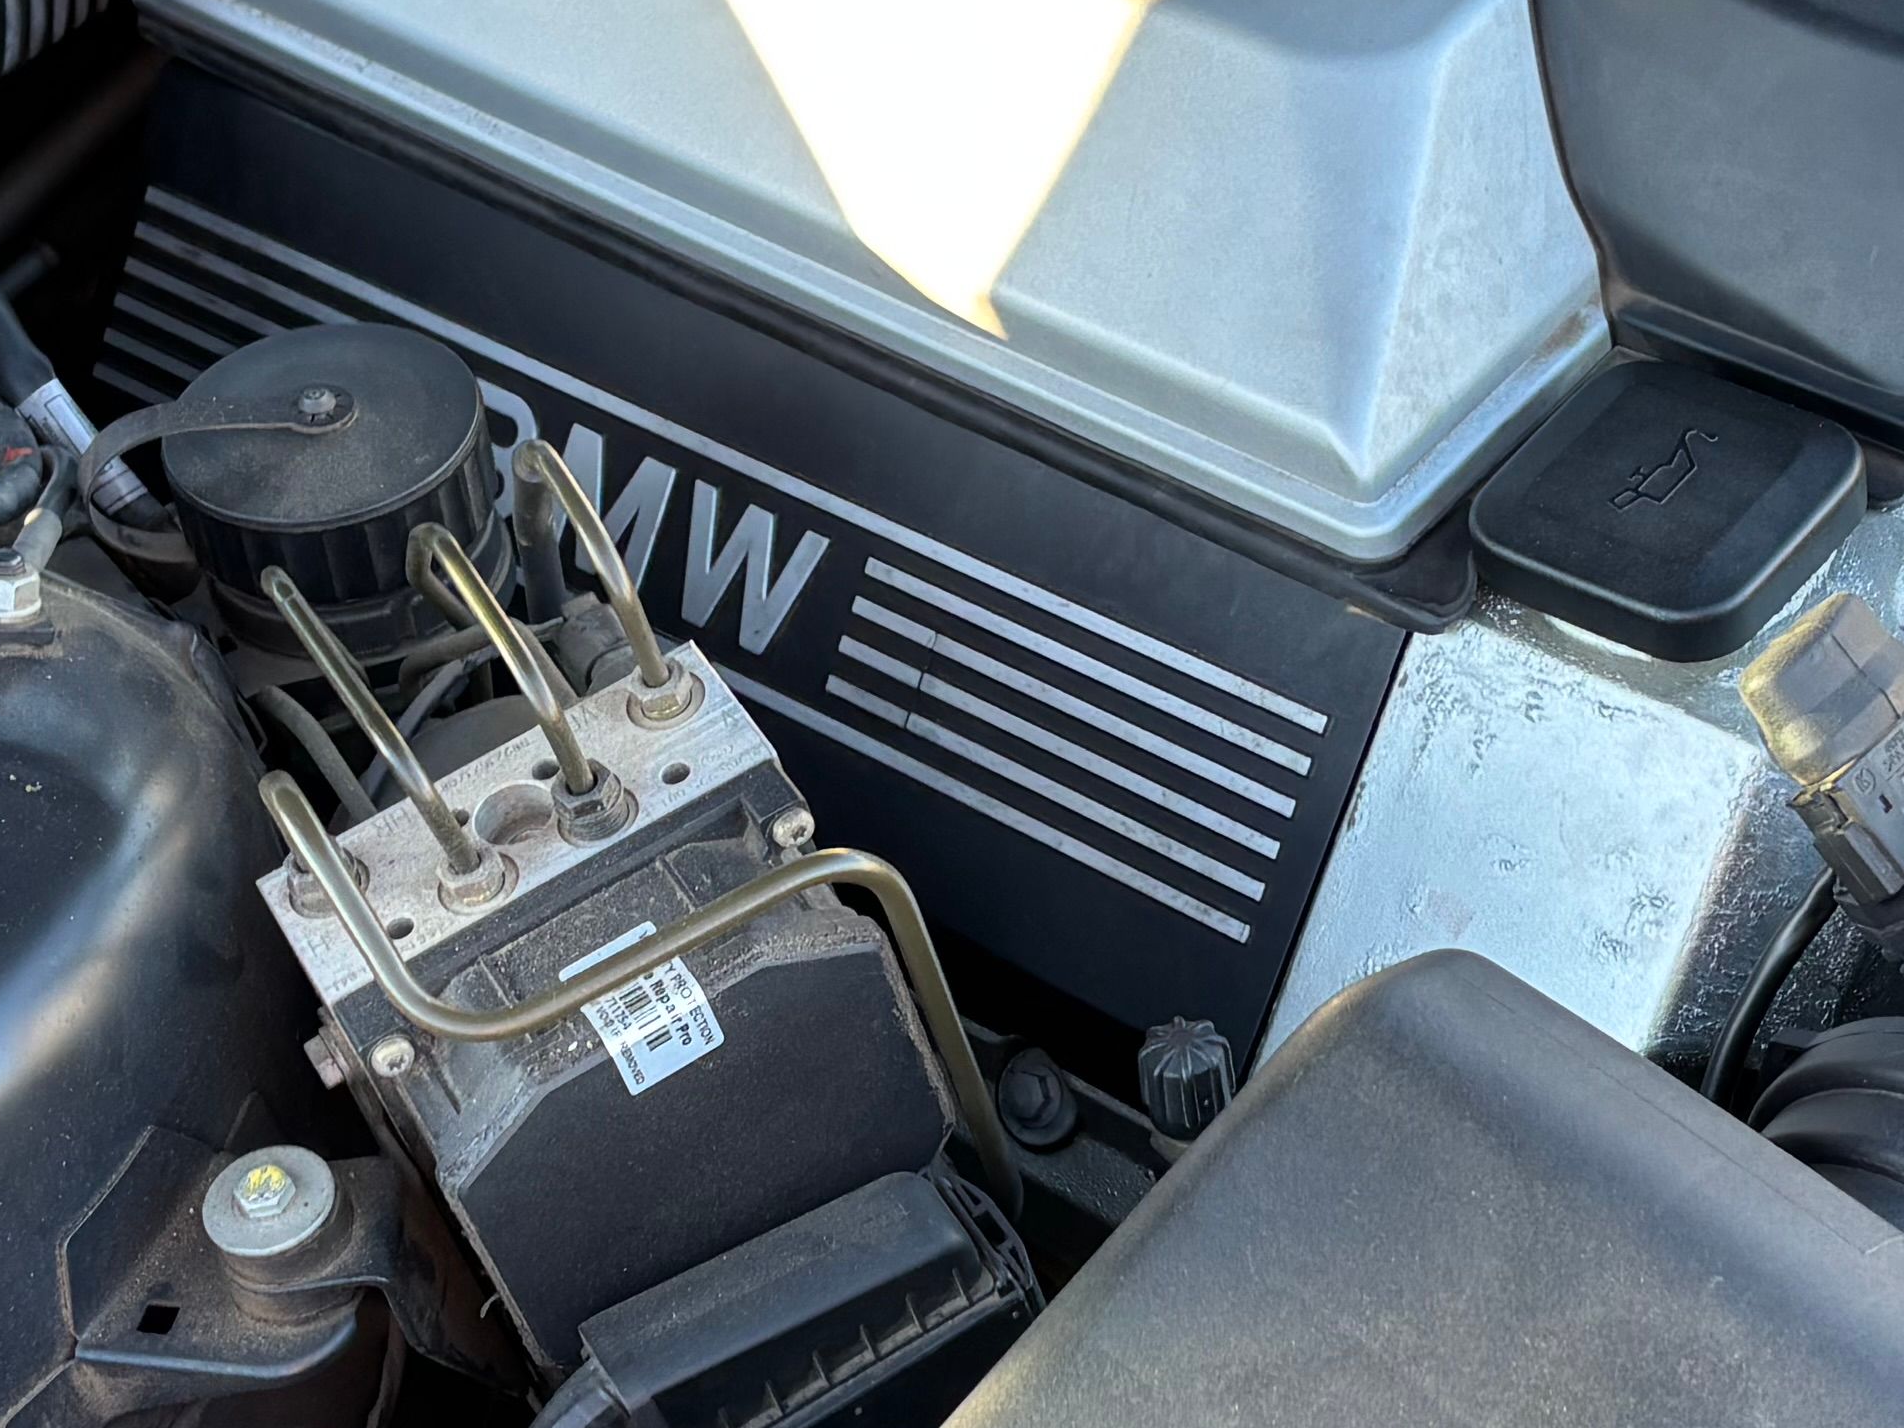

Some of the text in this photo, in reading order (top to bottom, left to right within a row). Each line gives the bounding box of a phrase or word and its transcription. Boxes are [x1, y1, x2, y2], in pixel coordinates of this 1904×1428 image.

[649, 979, 685, 1027] Repair
[674, 1022, 694, 1047] Pro
[669, 971, 717, 1046] PROTECTION
[619, 1039, 647, 1086] REMOVED
